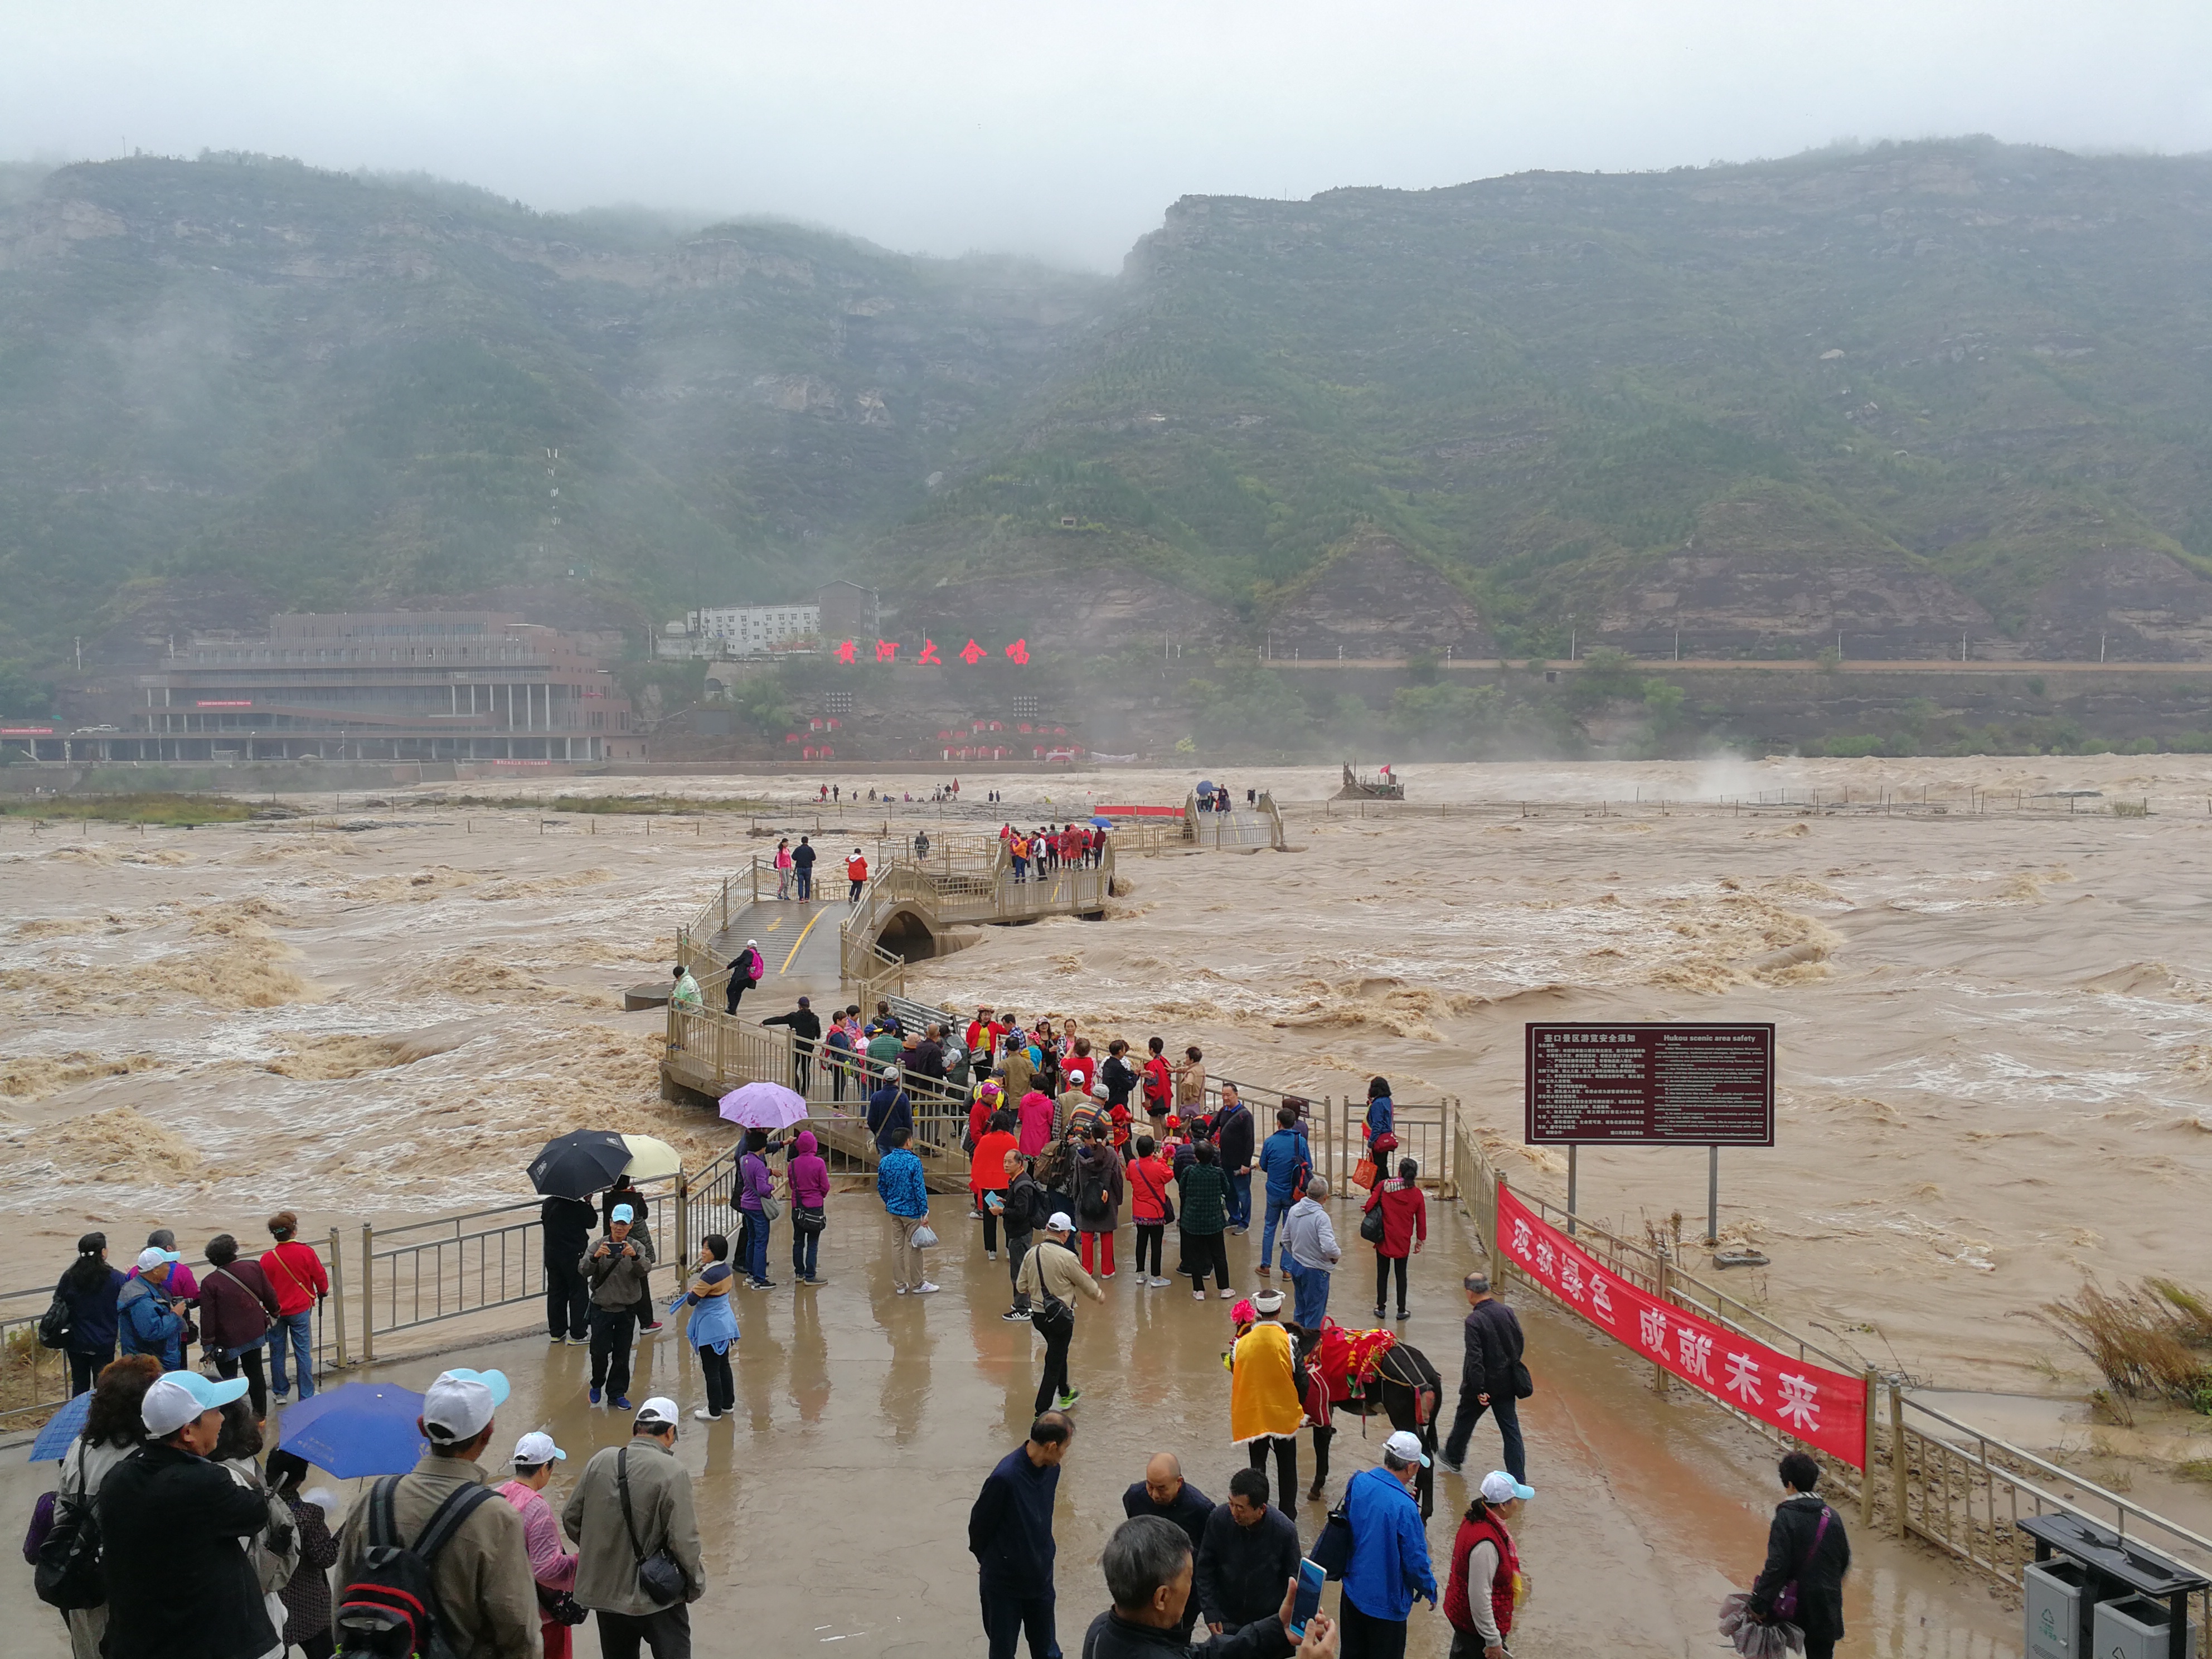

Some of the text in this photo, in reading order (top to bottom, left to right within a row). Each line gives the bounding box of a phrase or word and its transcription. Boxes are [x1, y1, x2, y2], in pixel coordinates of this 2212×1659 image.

[834, 639, 1030, 664] 黄河大合唱
[1544, 1034, 1636, 1042] 壶口景区游览安全须知
[1639, 1307, 1820, 1432] 成就未来
